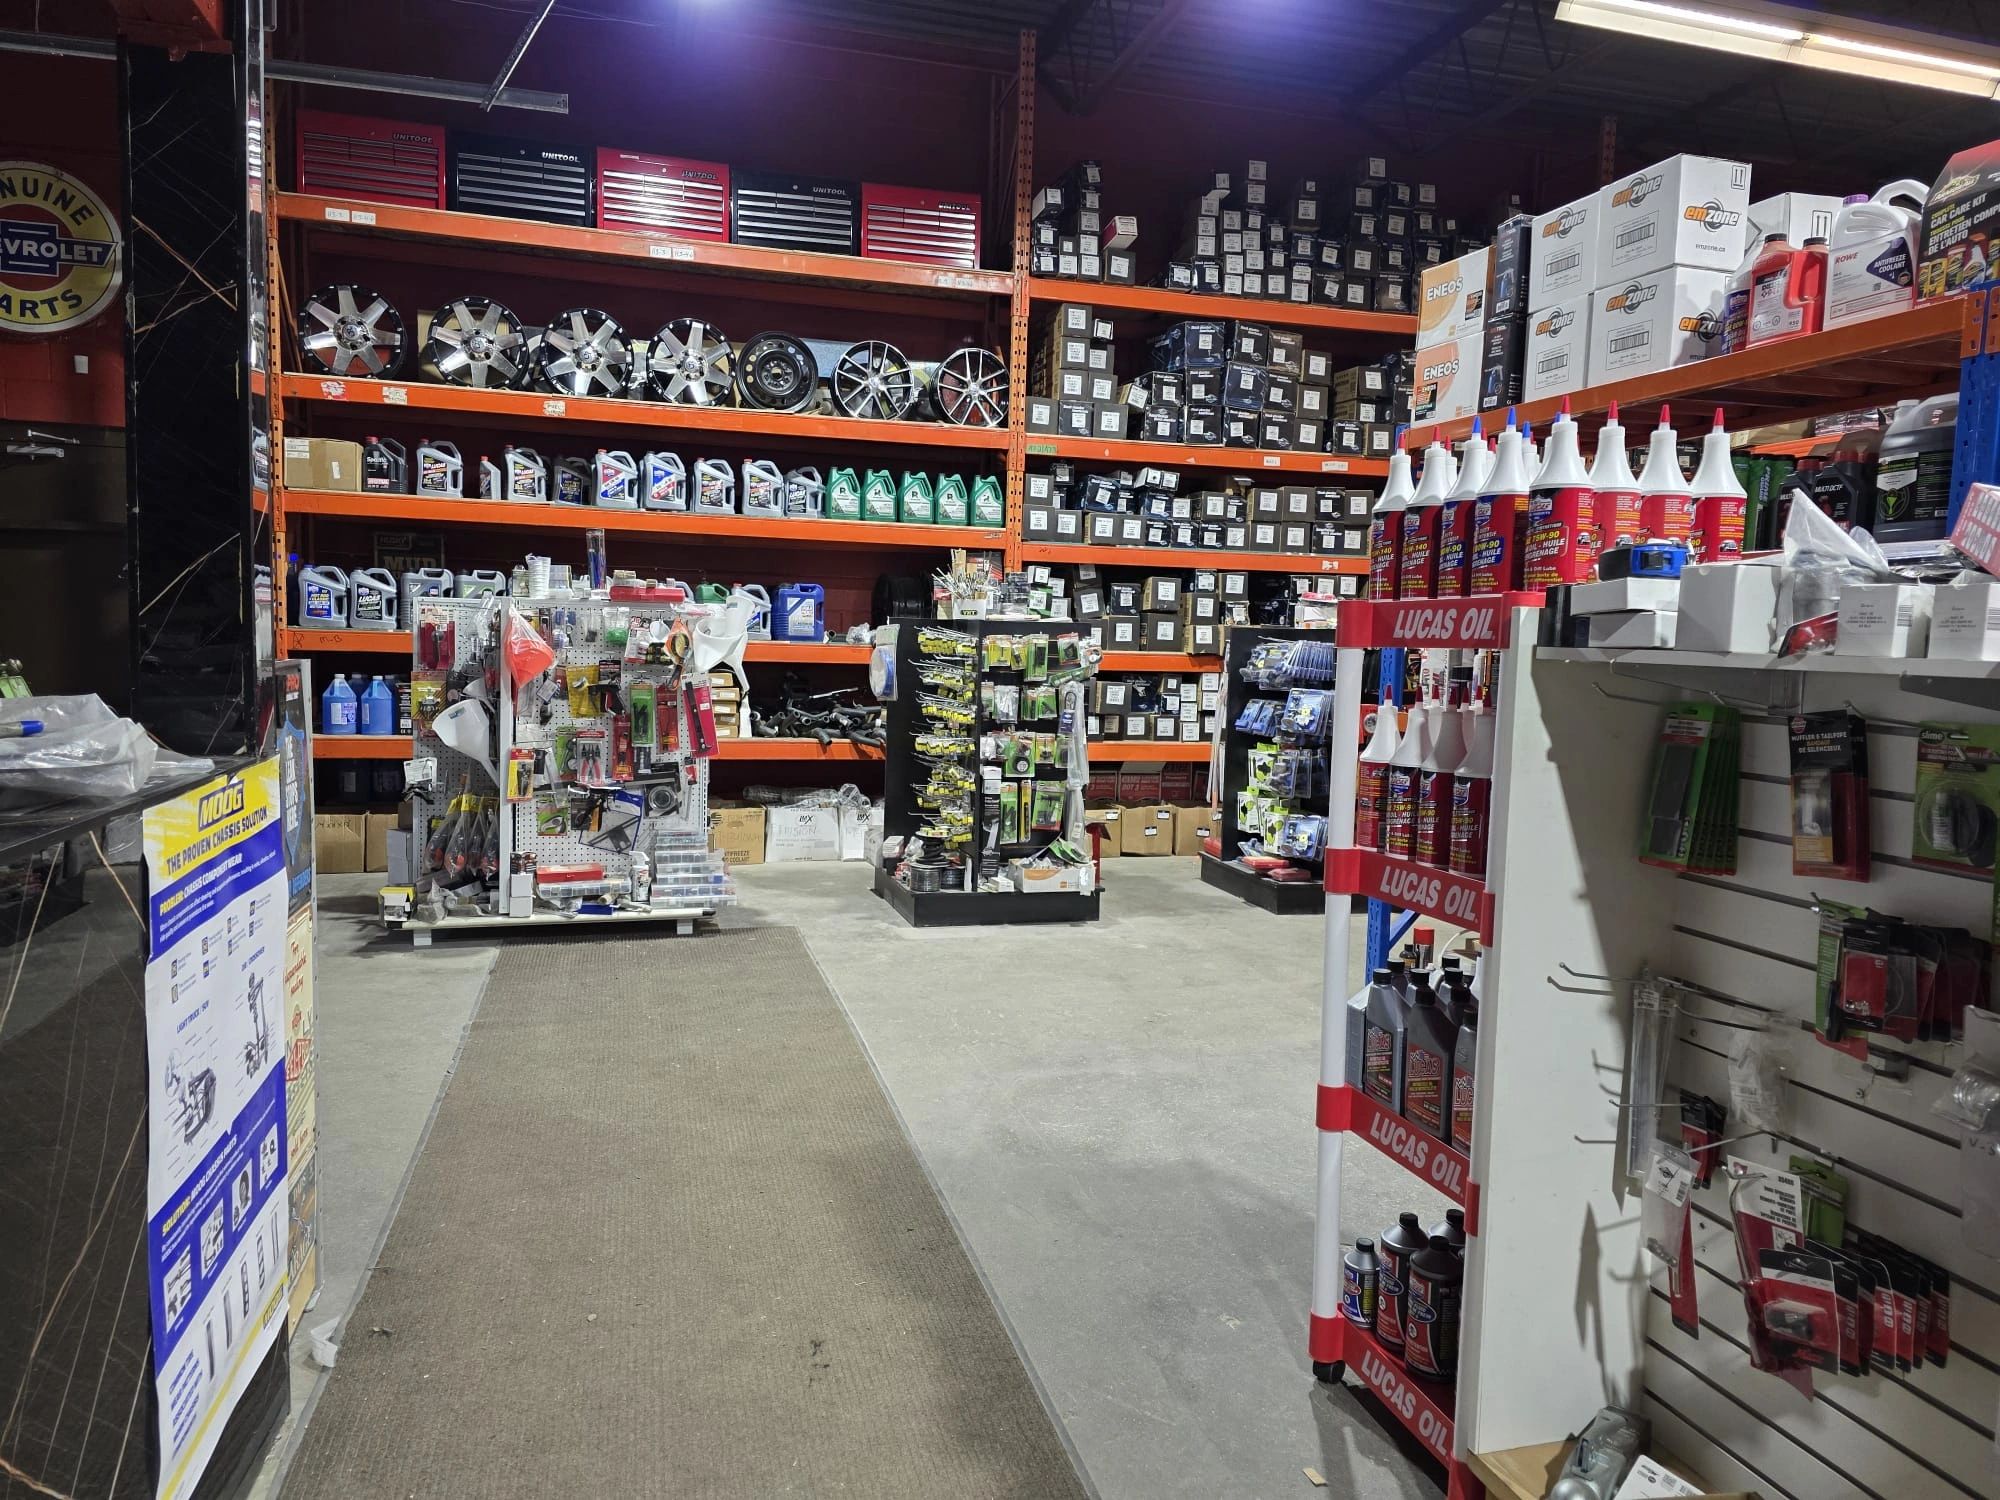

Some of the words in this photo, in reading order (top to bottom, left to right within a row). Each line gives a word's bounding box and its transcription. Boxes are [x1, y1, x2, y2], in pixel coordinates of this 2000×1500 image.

[392, 133, 433, 144] UNITOOL
[542, 151, 581, 164] UNITOOL
[812, 186, 847, 197] UNITOOL
[1612, 174, 1663, 209] emzone
[1683, 204, 1741, 227] emzone
[1930, 213, 1948, 229] CAR
[1949, 200, 1972, 219] CARE
[1972, 192, 1988, 208] KIT
[1542, 208, 1587, 239] emzone
[1929, 218, 1972, 247] ENTRETIEN
[0, 238, 103, 263] VROLET
[1928, 244, 1940, 256] DE
[1940, 230, 1969, 250] L'AUTO
[1835, 252, 1859, 265] ROWE
[1874, 253, 1907, 268] ANTIFREEZE
[1879, 260, 1906, 274] COOLANT
[1426, 277, 1464, 302] ENEOS
[1606, 284, 1658, 313] emzone
[1535, 310, 1575, 337] emzone
[1678, 315, 1724, 336] emzon
[1423, 358, 1460, 383] ENEOS
[1411, 550, 1431, 559] HUILE
[1482, 548, 1501, 557] HUILE
[1543, 538, 1566, 549] HUILE
[1378, 553, 1395, 562] HUILE
[1446, 551, 1464, 560] HUILE
[359, 594, 381, 603] LUCAS
[1393, 606, 1458, 640] LUCAS
[1460, 608, 1495, 641] OIL
[1791, 733, 1814, 742] MUFFLER
[1920, 731, 1942, 741] slime
[200, 785, 243, 828] MOOG
[166, 854, 182, 876] THE
[182, 836, 212, 867] PROVEN
[212, 821, 241, 848] CHASSIS
[241, 805, 268, 833] SOLUTION
[1380, 865, 1442, 910] LUCAS
[1443, 884, 1478, 922] OIL
[1408, 1057, 1441, 1077] LUCAS
[1455, 1087, 1474, 1107] LUC
[1370, 1112, 1429, 1170] LUCAS
[1431, 1152, 1464, 1195] OIL
[191, 1176, 206, 1201] MOOG
[1360, 1348, 1417, 1421] LUCAS
[1418, 1411, 1448, 1457] OIL
